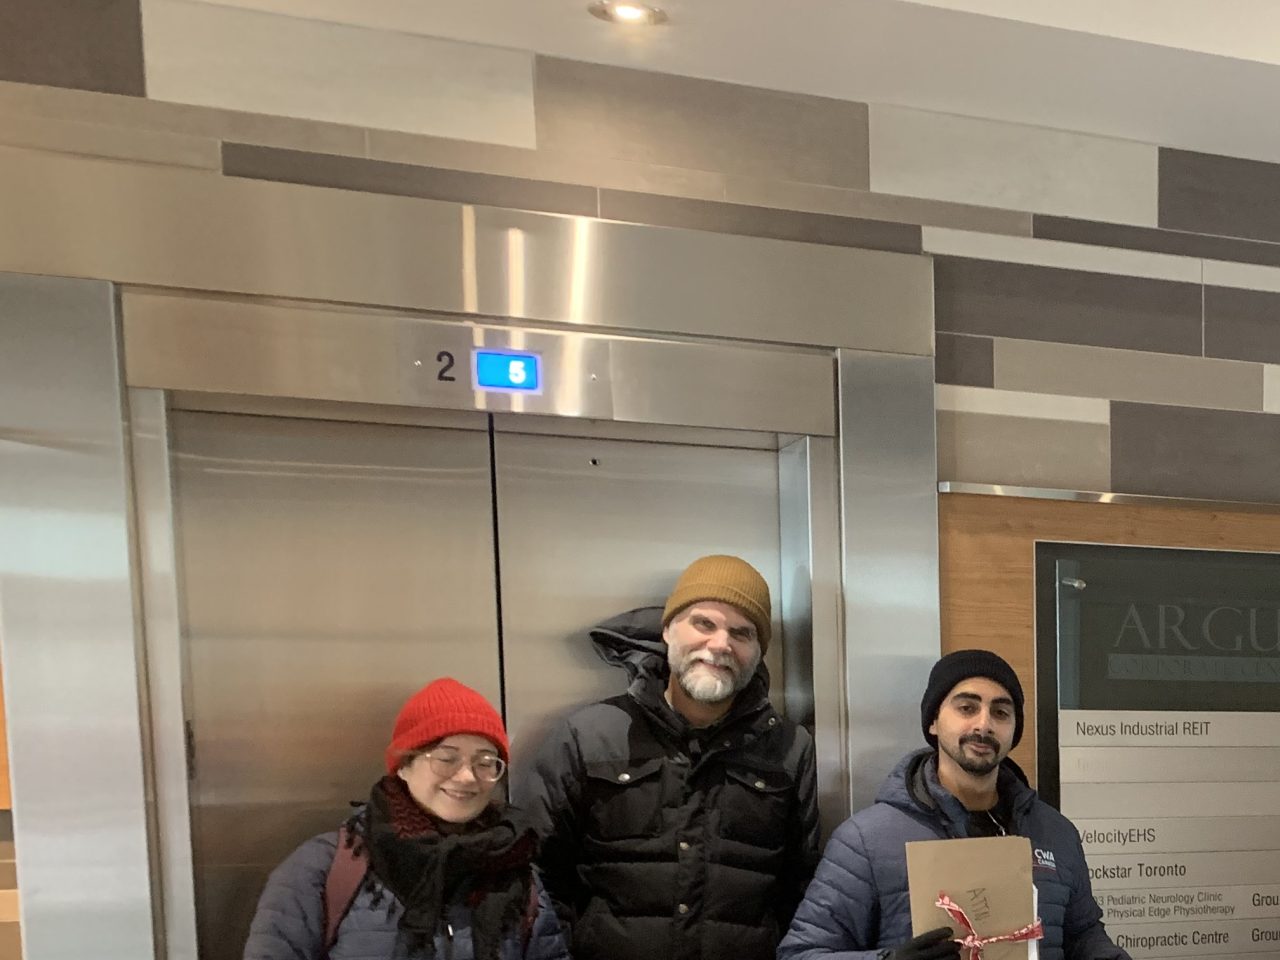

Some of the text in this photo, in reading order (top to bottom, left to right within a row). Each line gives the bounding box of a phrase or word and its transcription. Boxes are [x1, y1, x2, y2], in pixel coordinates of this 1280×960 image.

[436, 350, 456, 382] 2
[1076, 721, 1211, 736] Nexus Industrial REIT
[1034, 848, 1054, 861] CWA
[1088, 863, 1187, 879] ockstar Toronto
[1107, 894, 1146, 906] Pediatric
[1150, 893, 1195, 905] Neurology
[1197, 891, 1223, 903] Clinic
[1107, 903, 1235, 919] Physical Edge Physiotherapy
[1116, 930, 1229, 950] Chiropractic Centre
